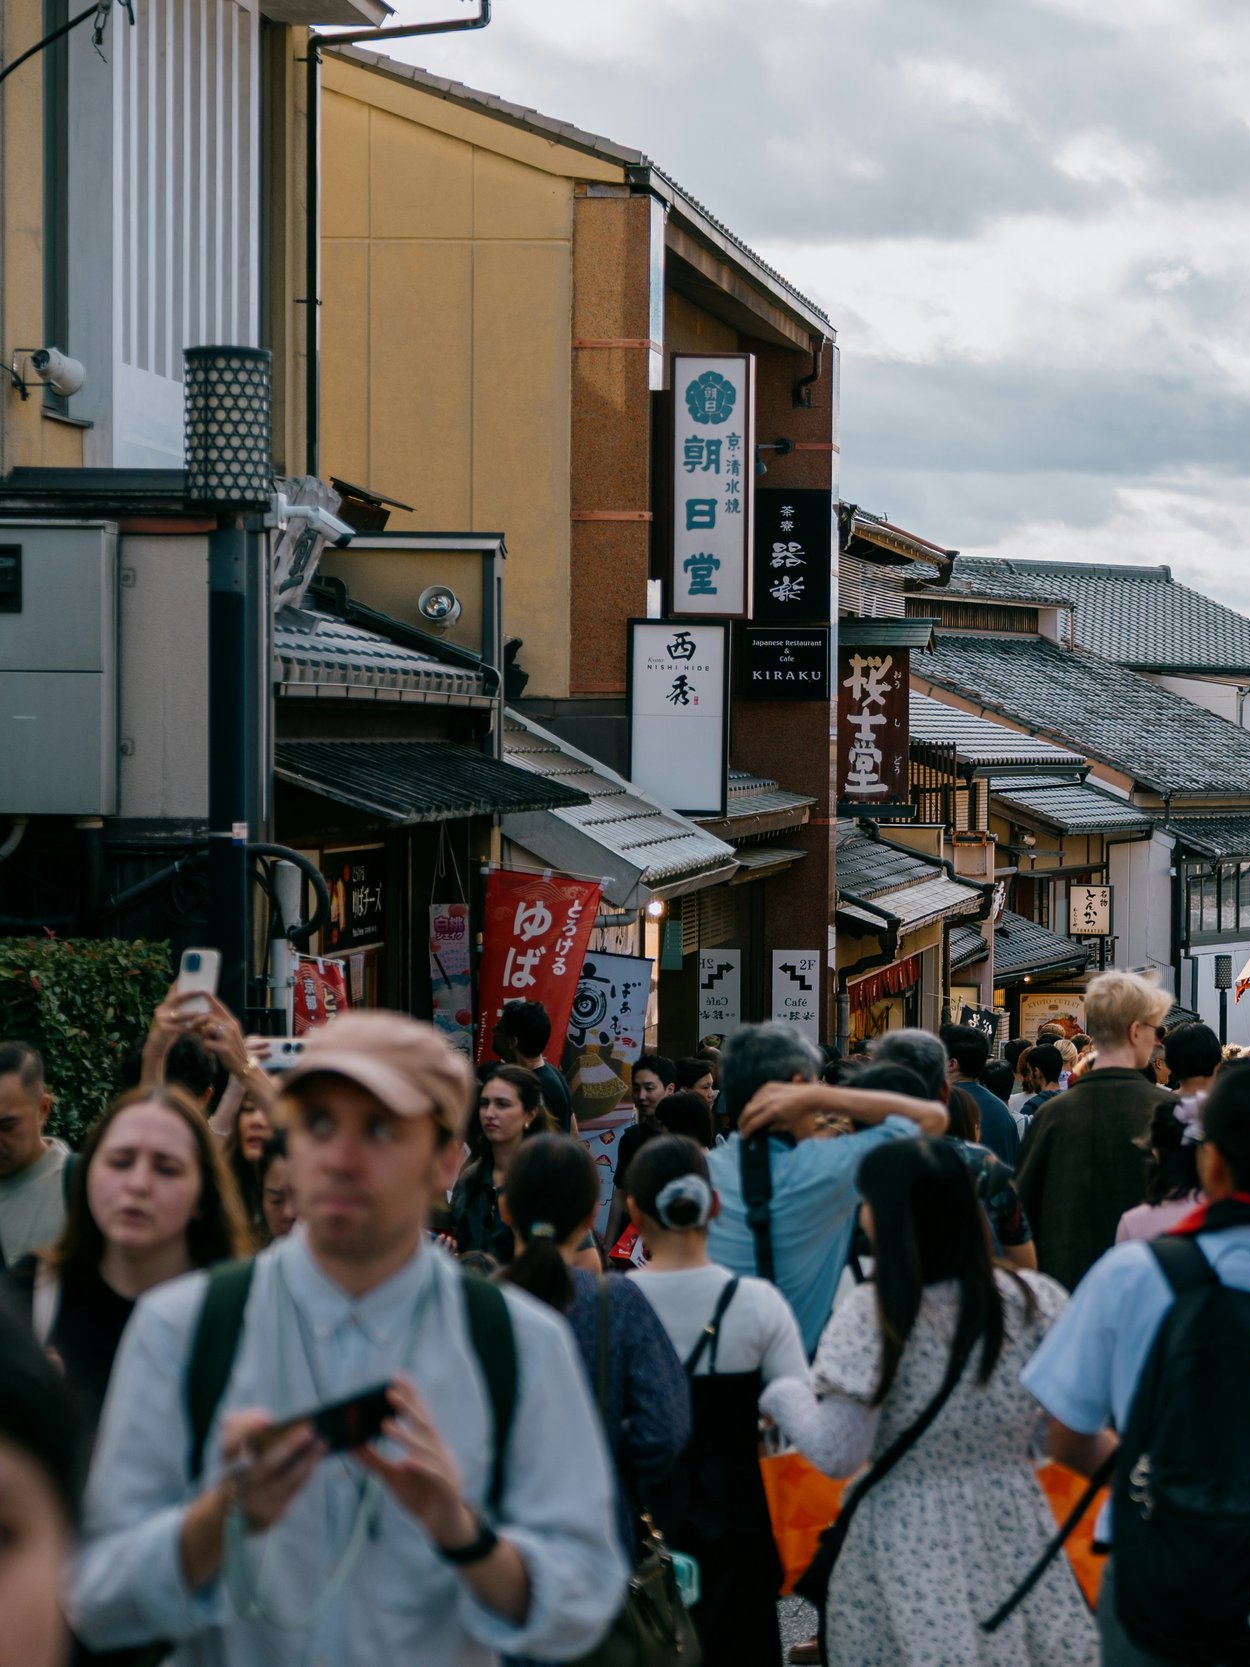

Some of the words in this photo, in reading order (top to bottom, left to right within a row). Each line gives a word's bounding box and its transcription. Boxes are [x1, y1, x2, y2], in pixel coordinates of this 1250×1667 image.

[704, 387, 717, 412] 朝日
[683, 435, 722, 595] 朝日堂
[666, 631, 696, 706] 西秀
[752, 670, 821, 681] KIRAKU
[843, 653, 893, 793] 桜士堂
[1083, 888, 1098, 927] とんかつ
[551, 900, 583, 976] とろける
[800, 960, 816, 971] 2F
[784, 998, 808, 1007] Café
